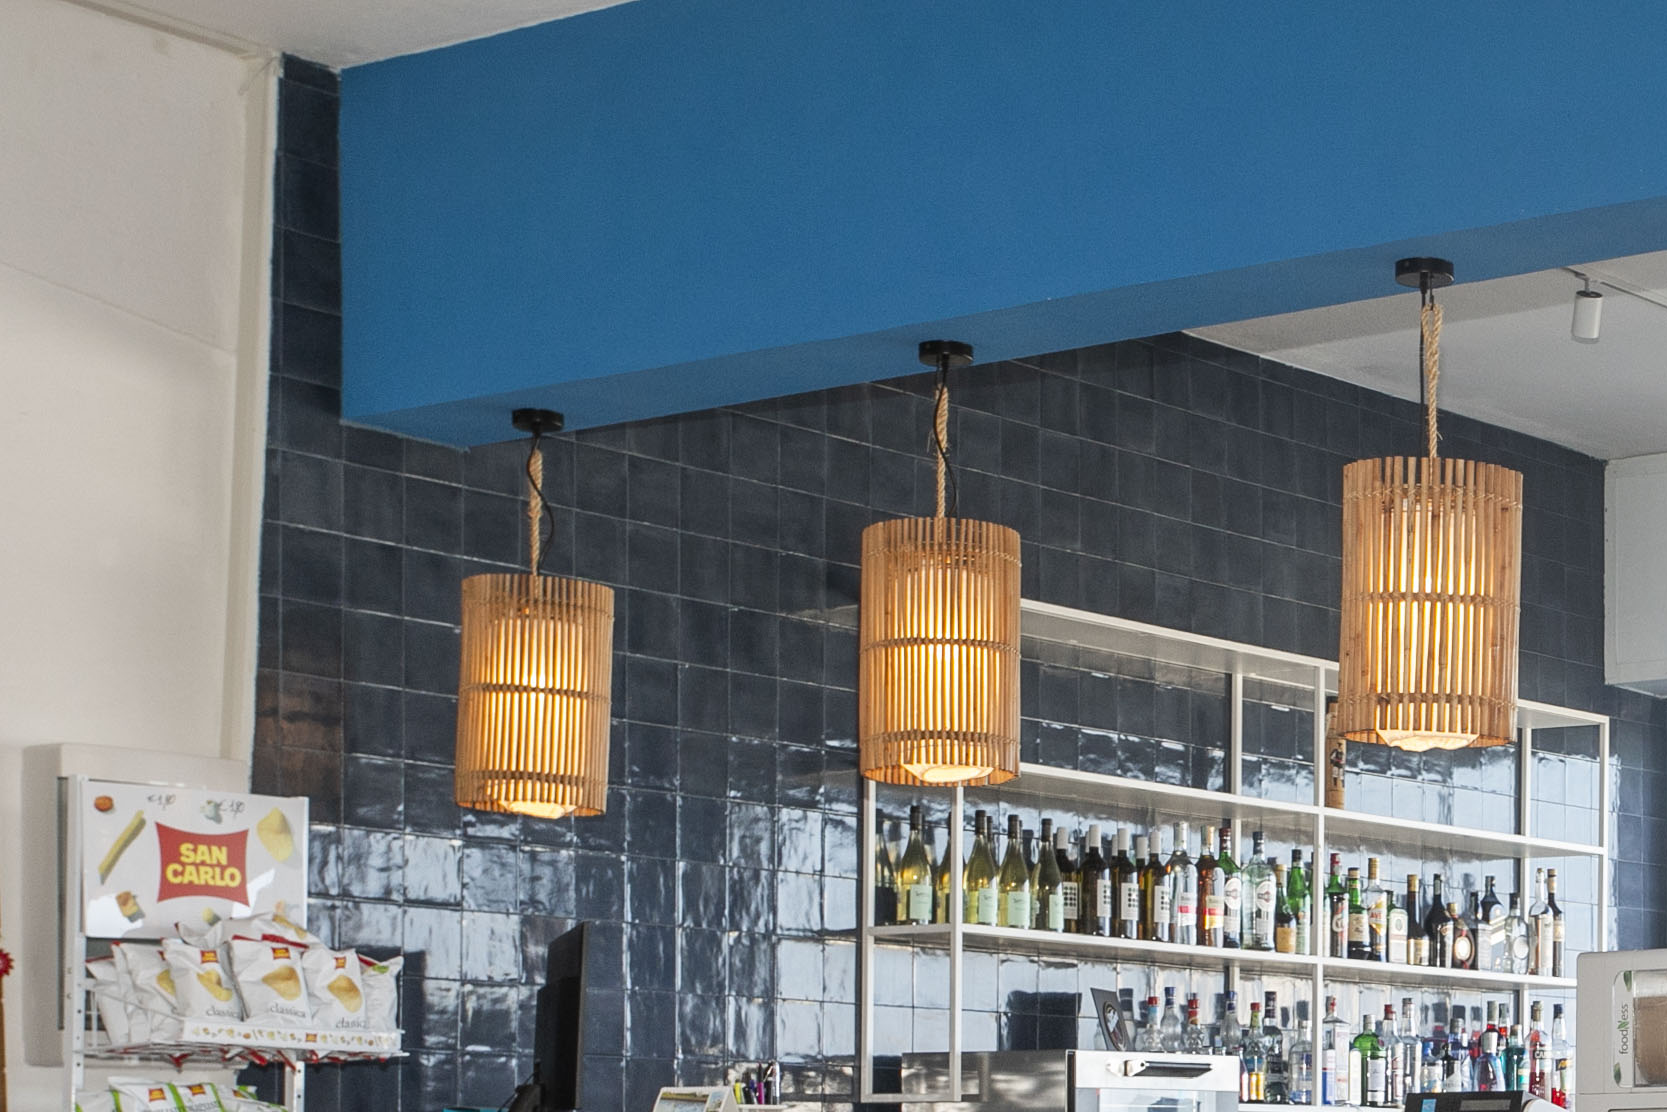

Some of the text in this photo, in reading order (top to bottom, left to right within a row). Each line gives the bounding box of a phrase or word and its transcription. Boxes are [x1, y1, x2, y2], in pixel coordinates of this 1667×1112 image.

[179, 842, 228, 865] SAN
[165, 863, 242, 888] CARLO
[1617, 1003, 1629, 1055] foodNess
